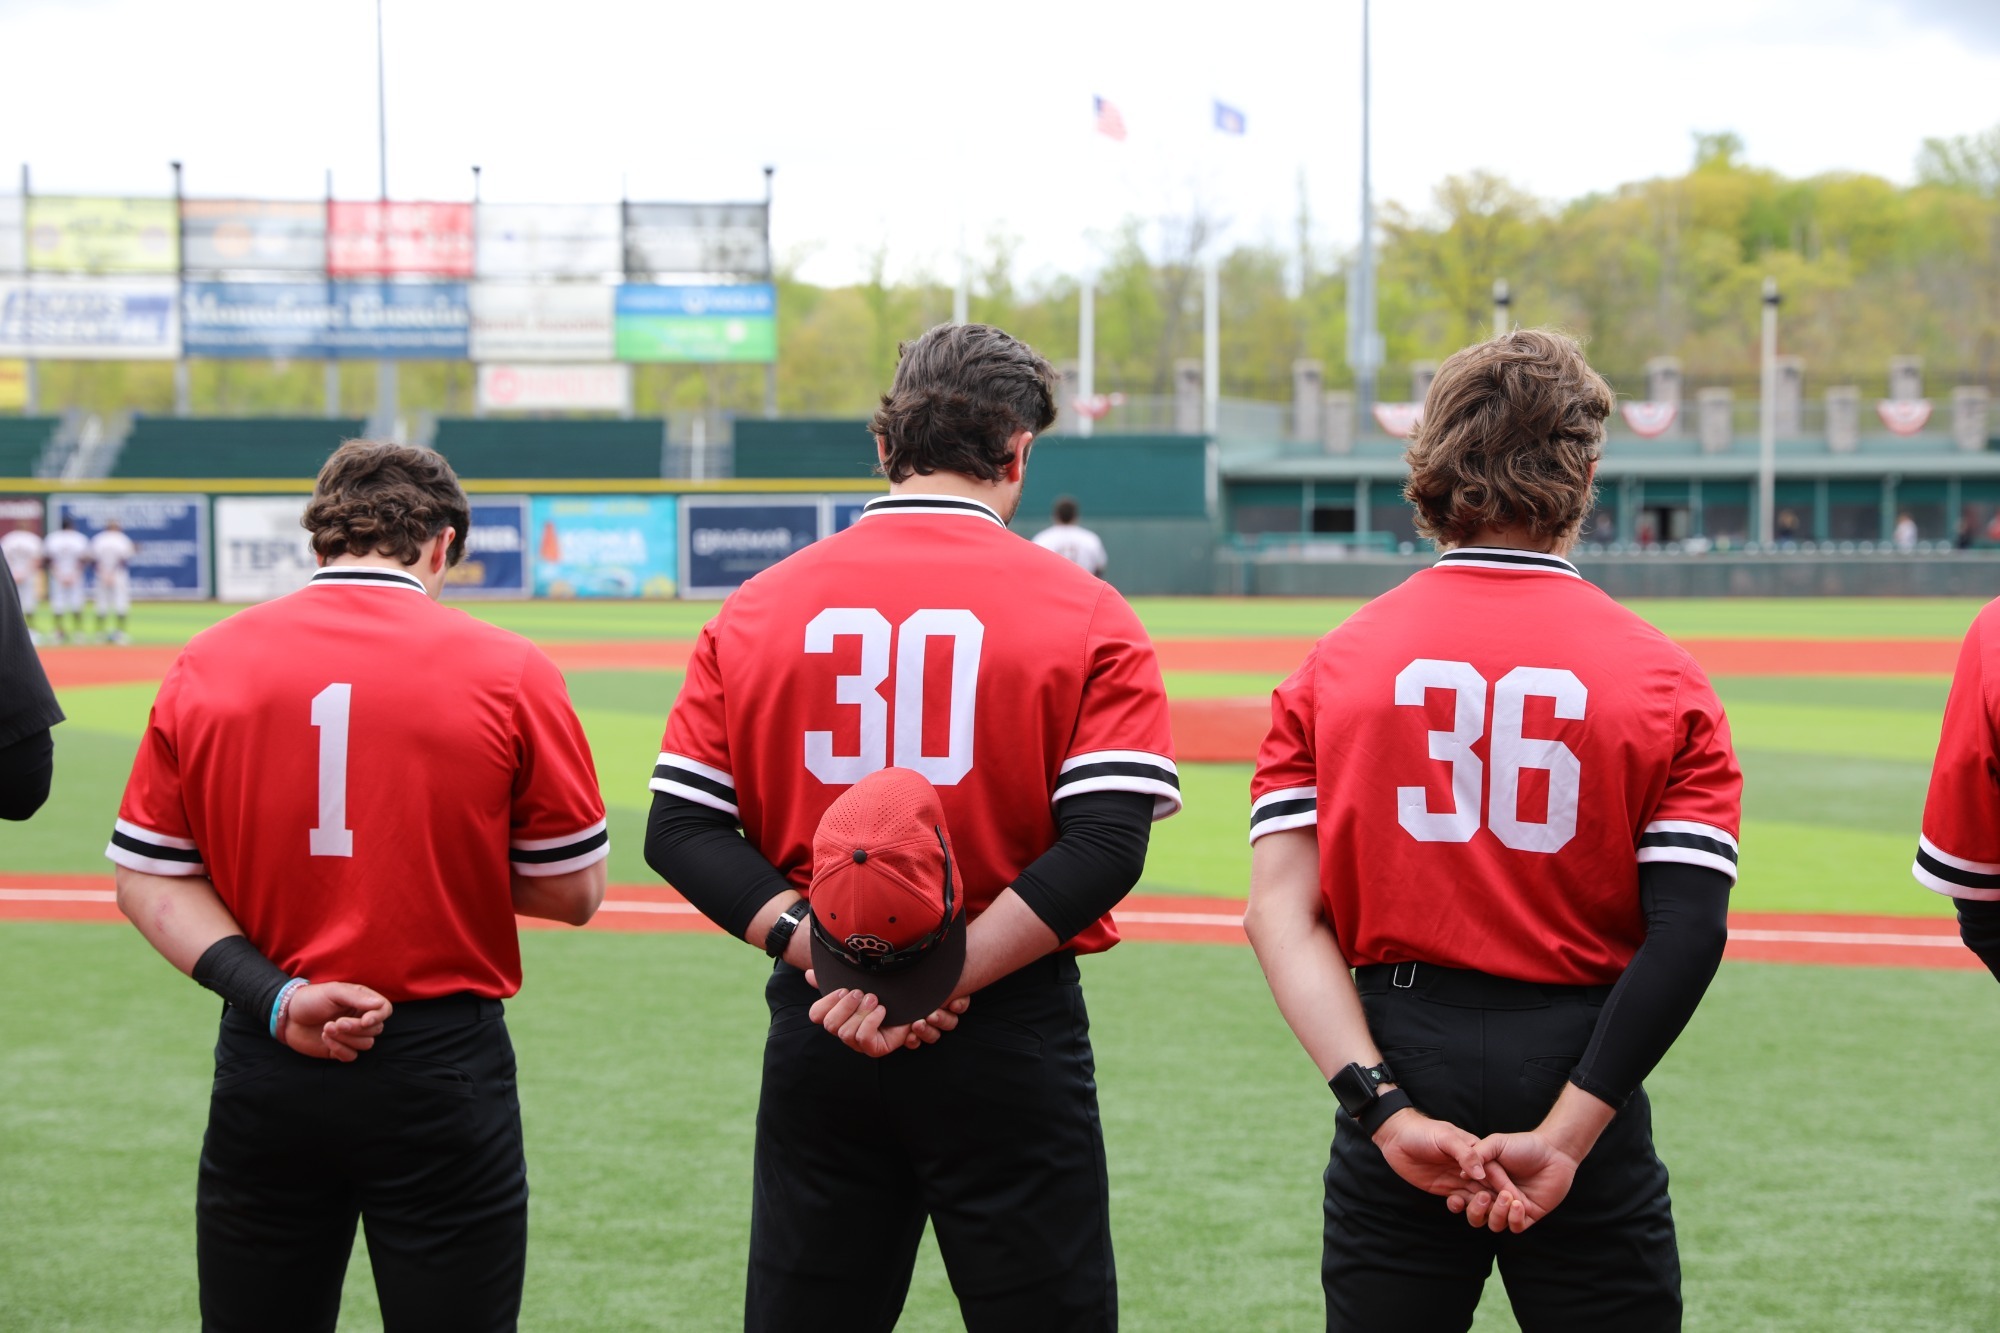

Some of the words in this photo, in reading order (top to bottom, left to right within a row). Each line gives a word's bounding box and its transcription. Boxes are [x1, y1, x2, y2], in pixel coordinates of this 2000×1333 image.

[309, 682, 354, 858] 1
[804, 607, 985, 786] 30
[1394, 658, 1588, 854] 36
